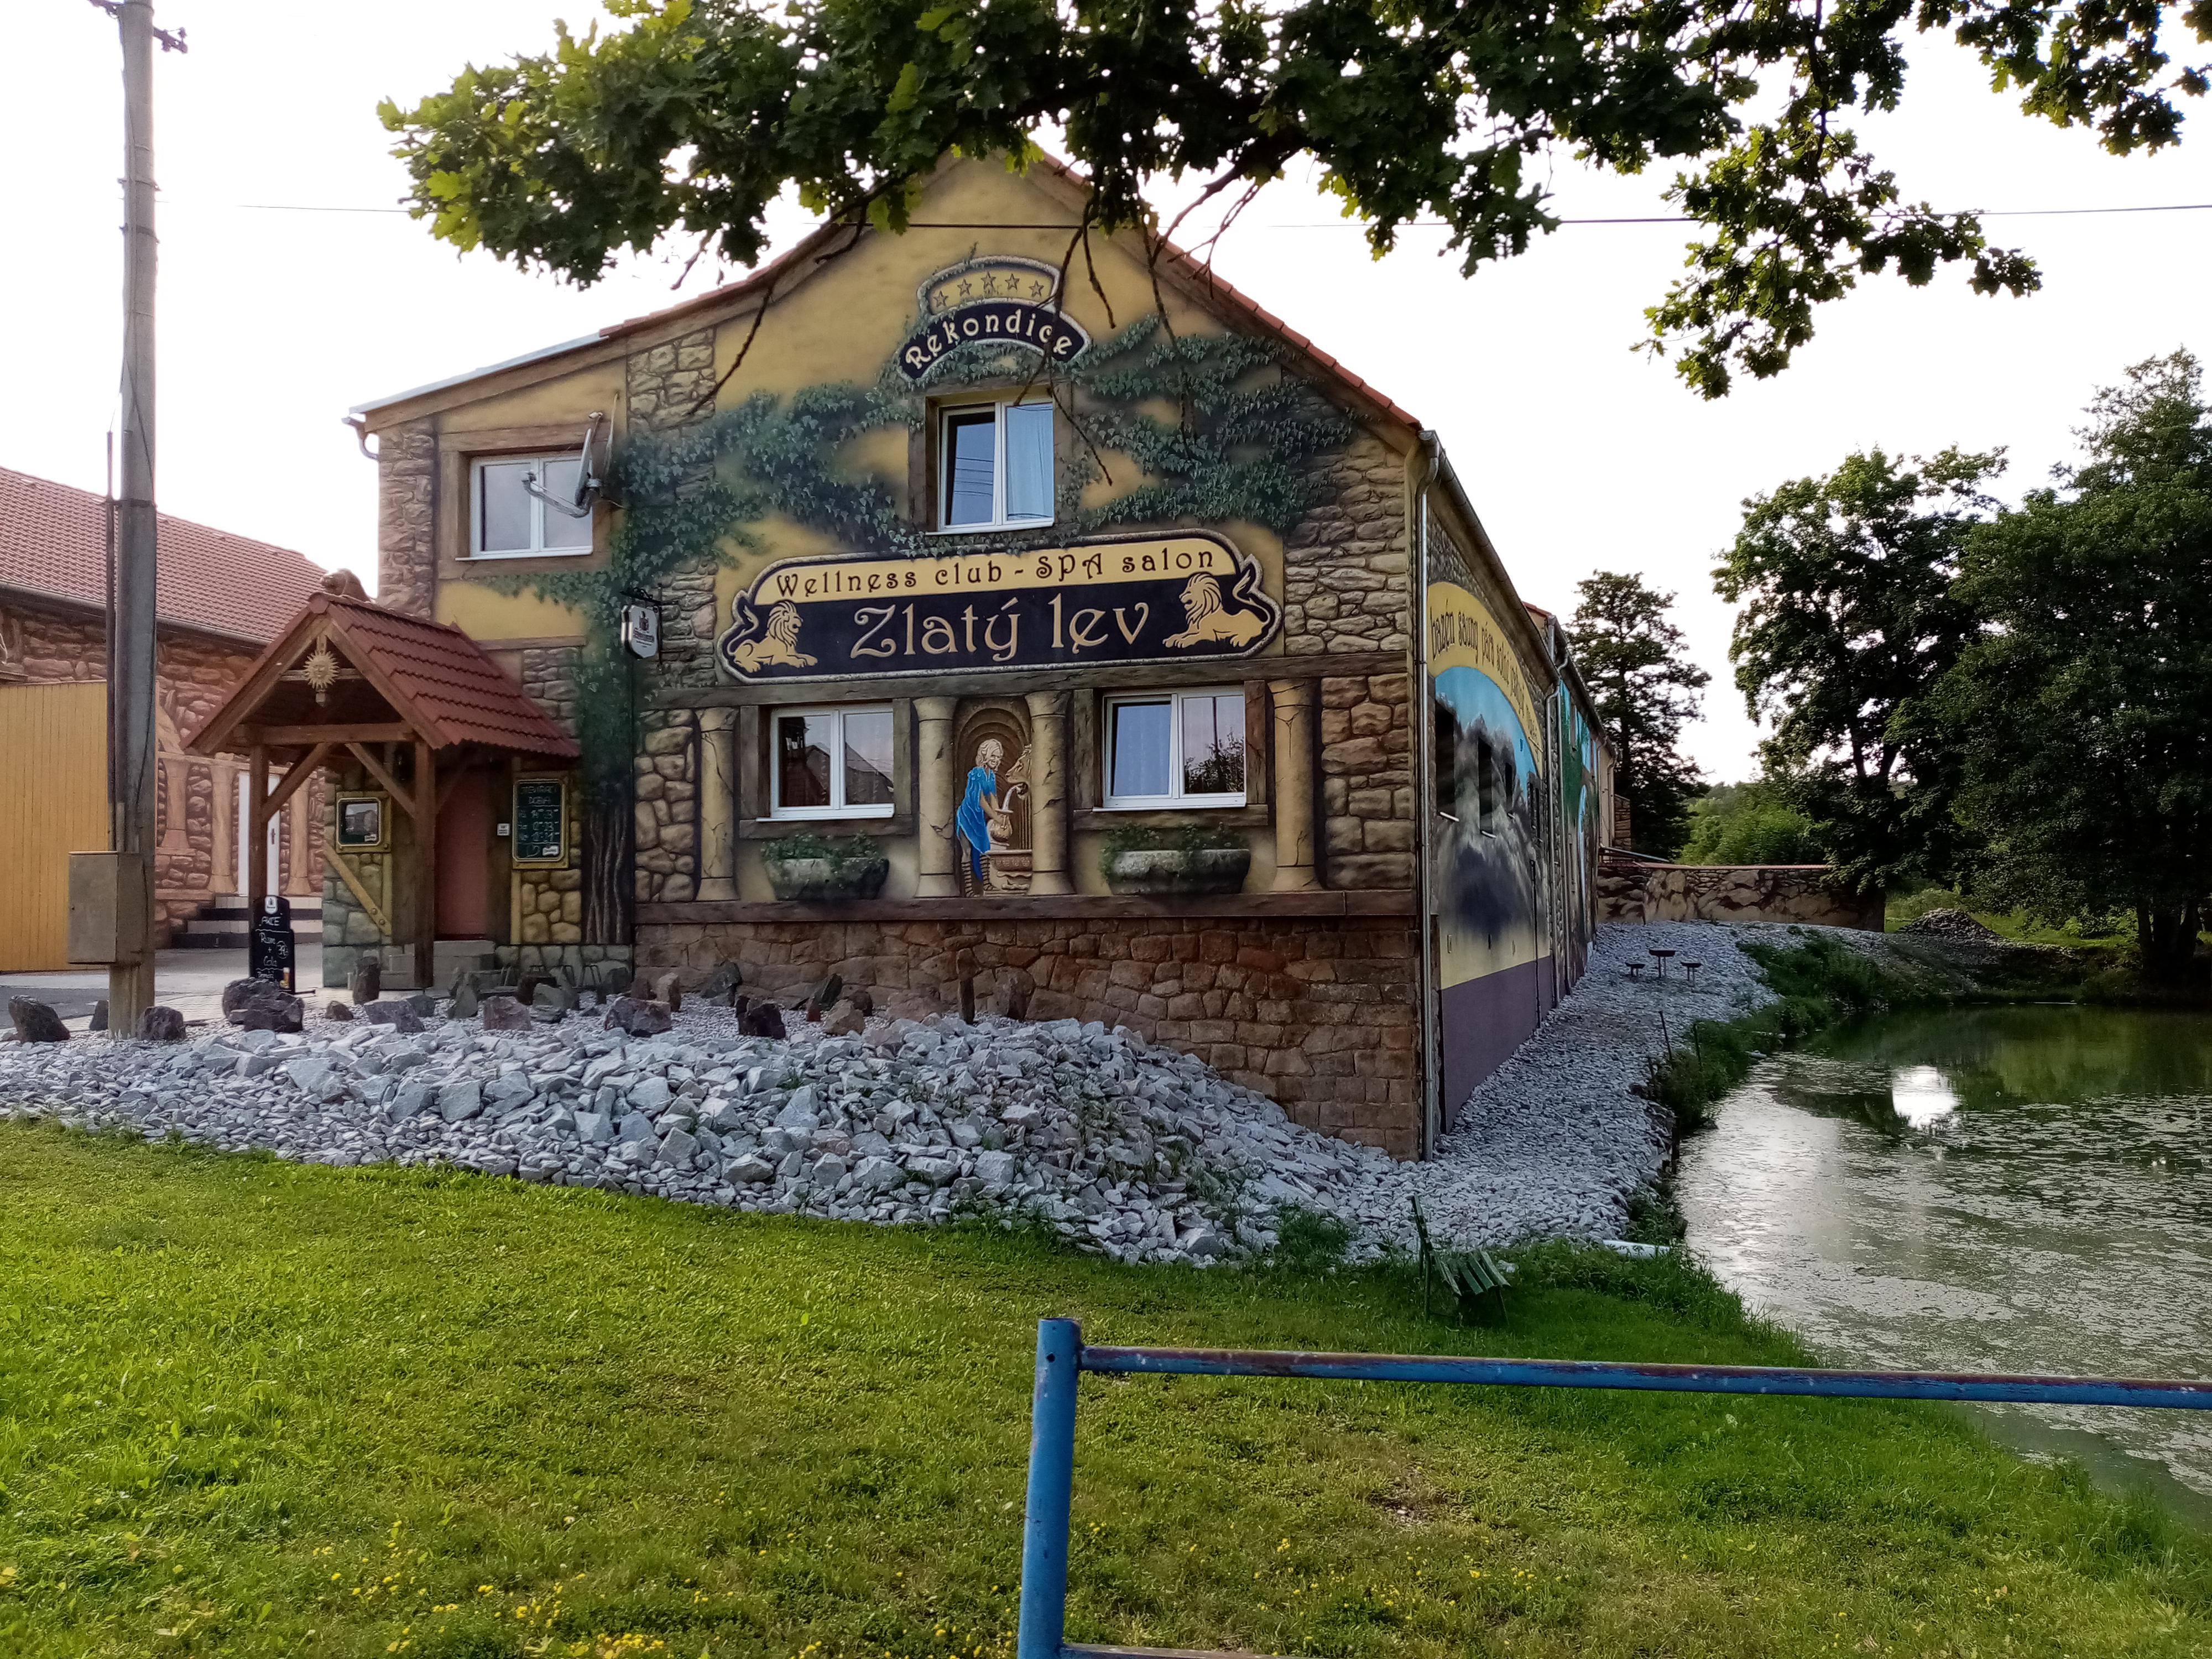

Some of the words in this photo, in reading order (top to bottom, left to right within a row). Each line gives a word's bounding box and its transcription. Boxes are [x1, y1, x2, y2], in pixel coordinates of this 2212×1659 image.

[905, 309, 1073, 370] Rekondice
[776, 570, 917, 597] Wellness
[935, 560, 1002, 586] club
[1036, 552, 1103, 582] SPA
[1121, 547, 1213, 573] salon
[850, 597, 1021, 662] Zlatý
[1047, 592, 1150, 654] lev
[1430, 598, 1455, 661] bazén
[1458, 611, 1478, 664] sauny
